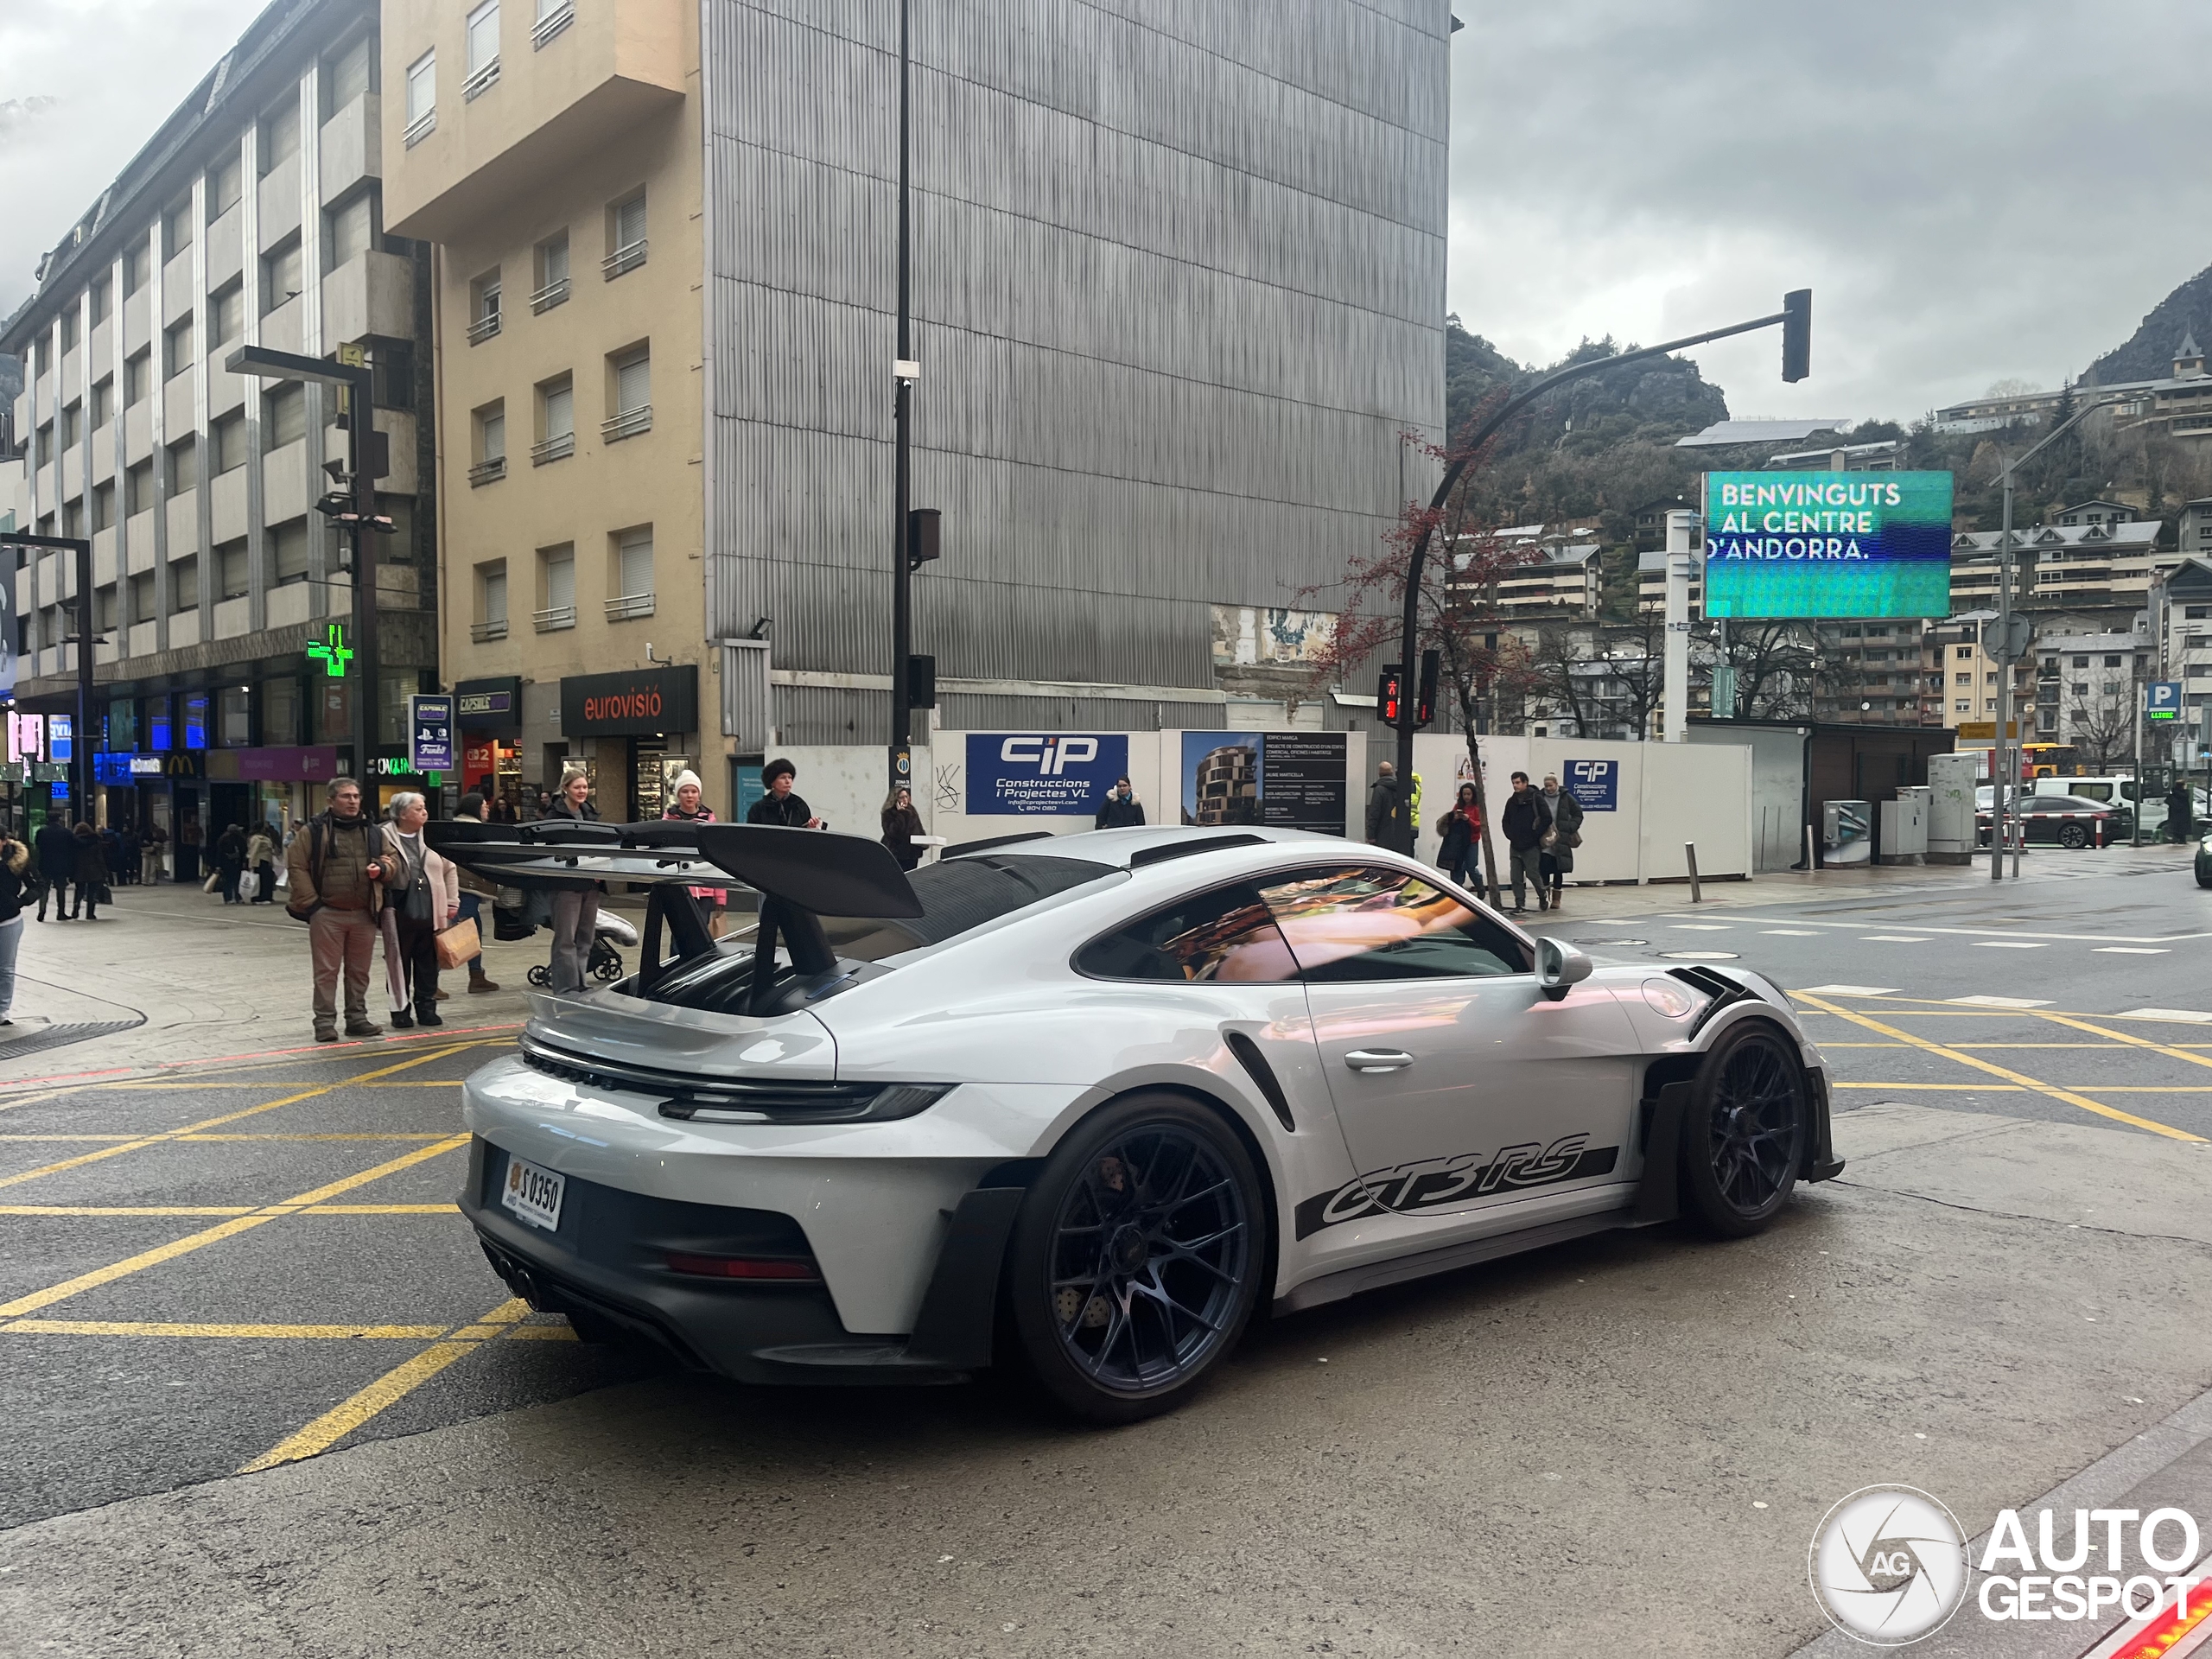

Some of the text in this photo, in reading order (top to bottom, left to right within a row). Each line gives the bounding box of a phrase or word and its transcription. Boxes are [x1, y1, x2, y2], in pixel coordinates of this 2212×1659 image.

[1721, 483, 1901, 507] BENVINGUTS
[1721, 511, 1873, 534] AL CENTRE
[585, 684, 662, 721] eurovisió
[2154, 685, 2172, 705] P
[480, 748, 489, 760] 2
[995, 779, 1090, 788] Construccions
[996, 789, 1090, 799] i Projectes VL
